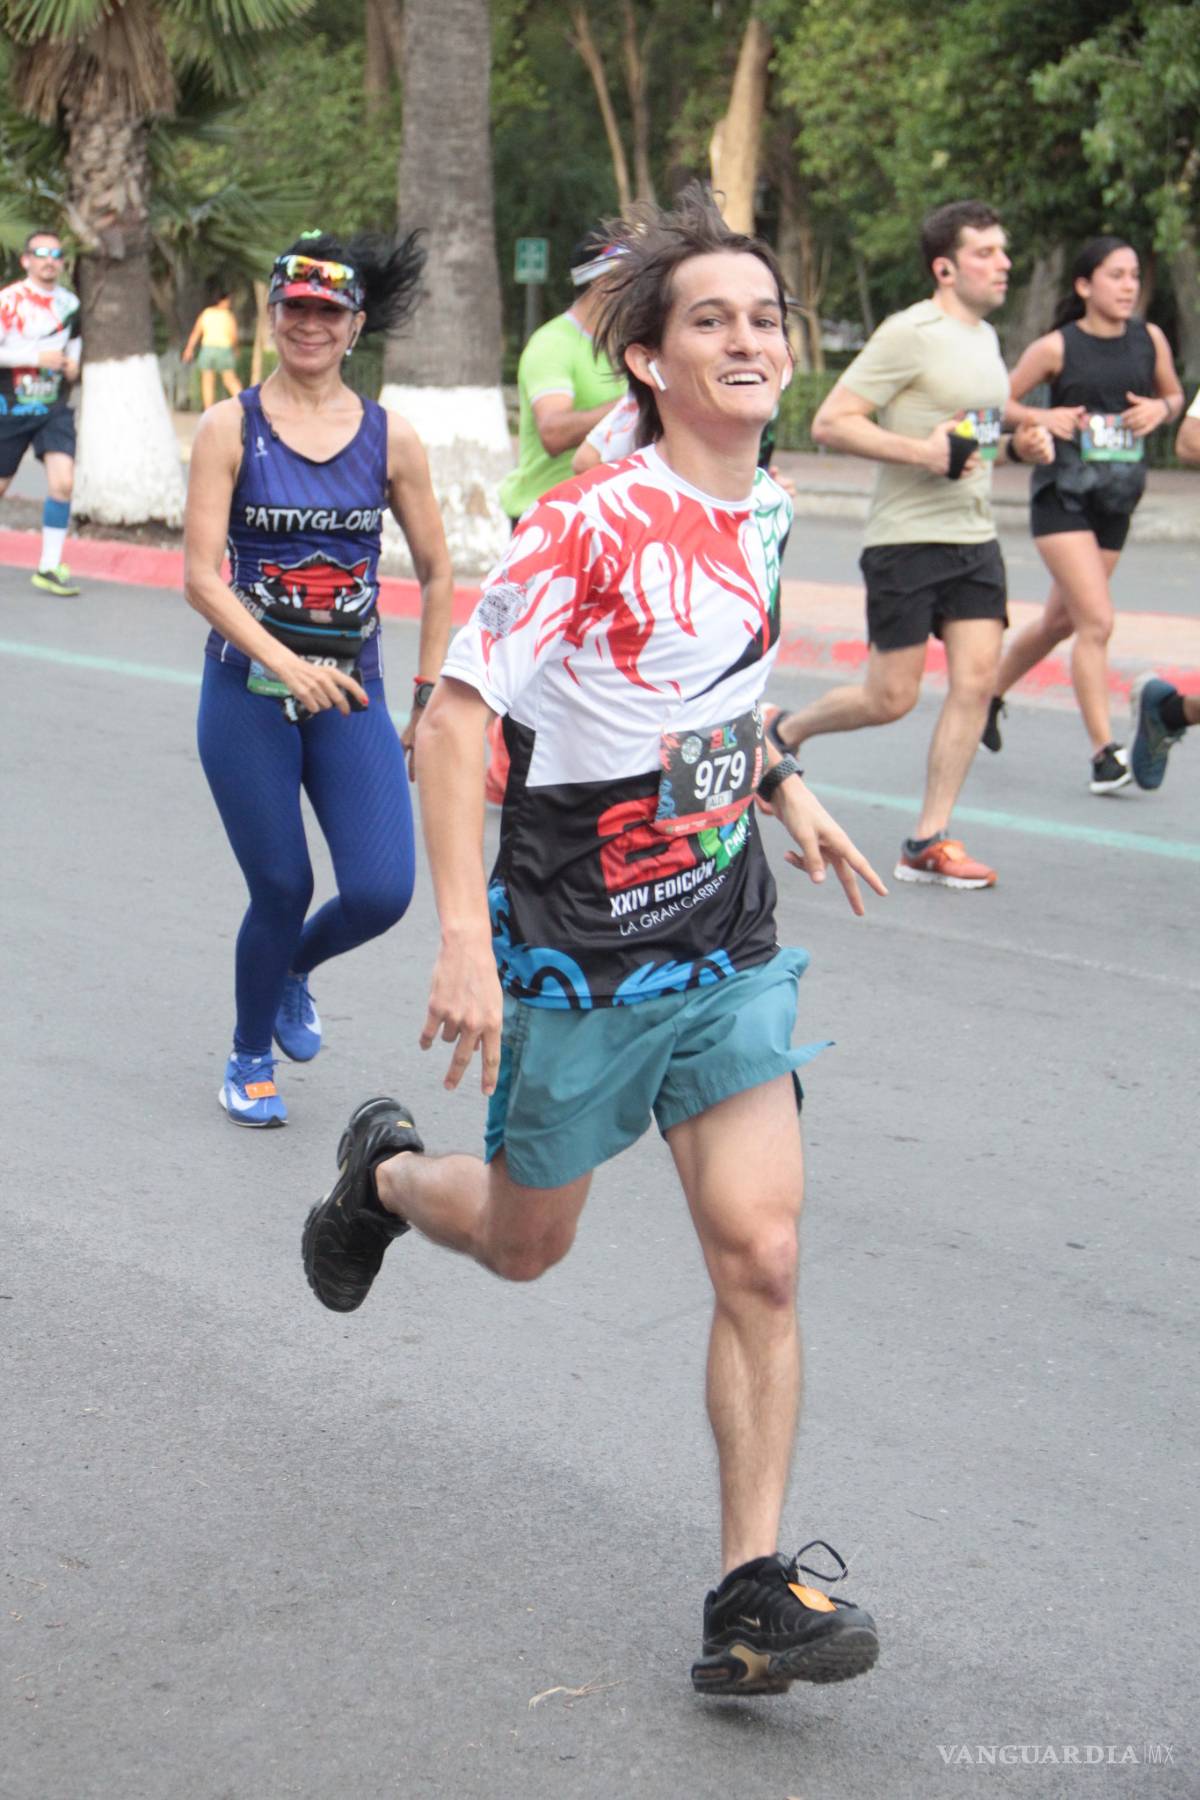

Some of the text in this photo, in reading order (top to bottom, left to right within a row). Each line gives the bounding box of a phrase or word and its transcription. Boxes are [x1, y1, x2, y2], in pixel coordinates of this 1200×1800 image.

[693, 750, 746, 800] 979
[609, 886, 650, 918] XXIV
[619, 921, 639, 937] LA
[640, 902, 681, 929] GRAN
